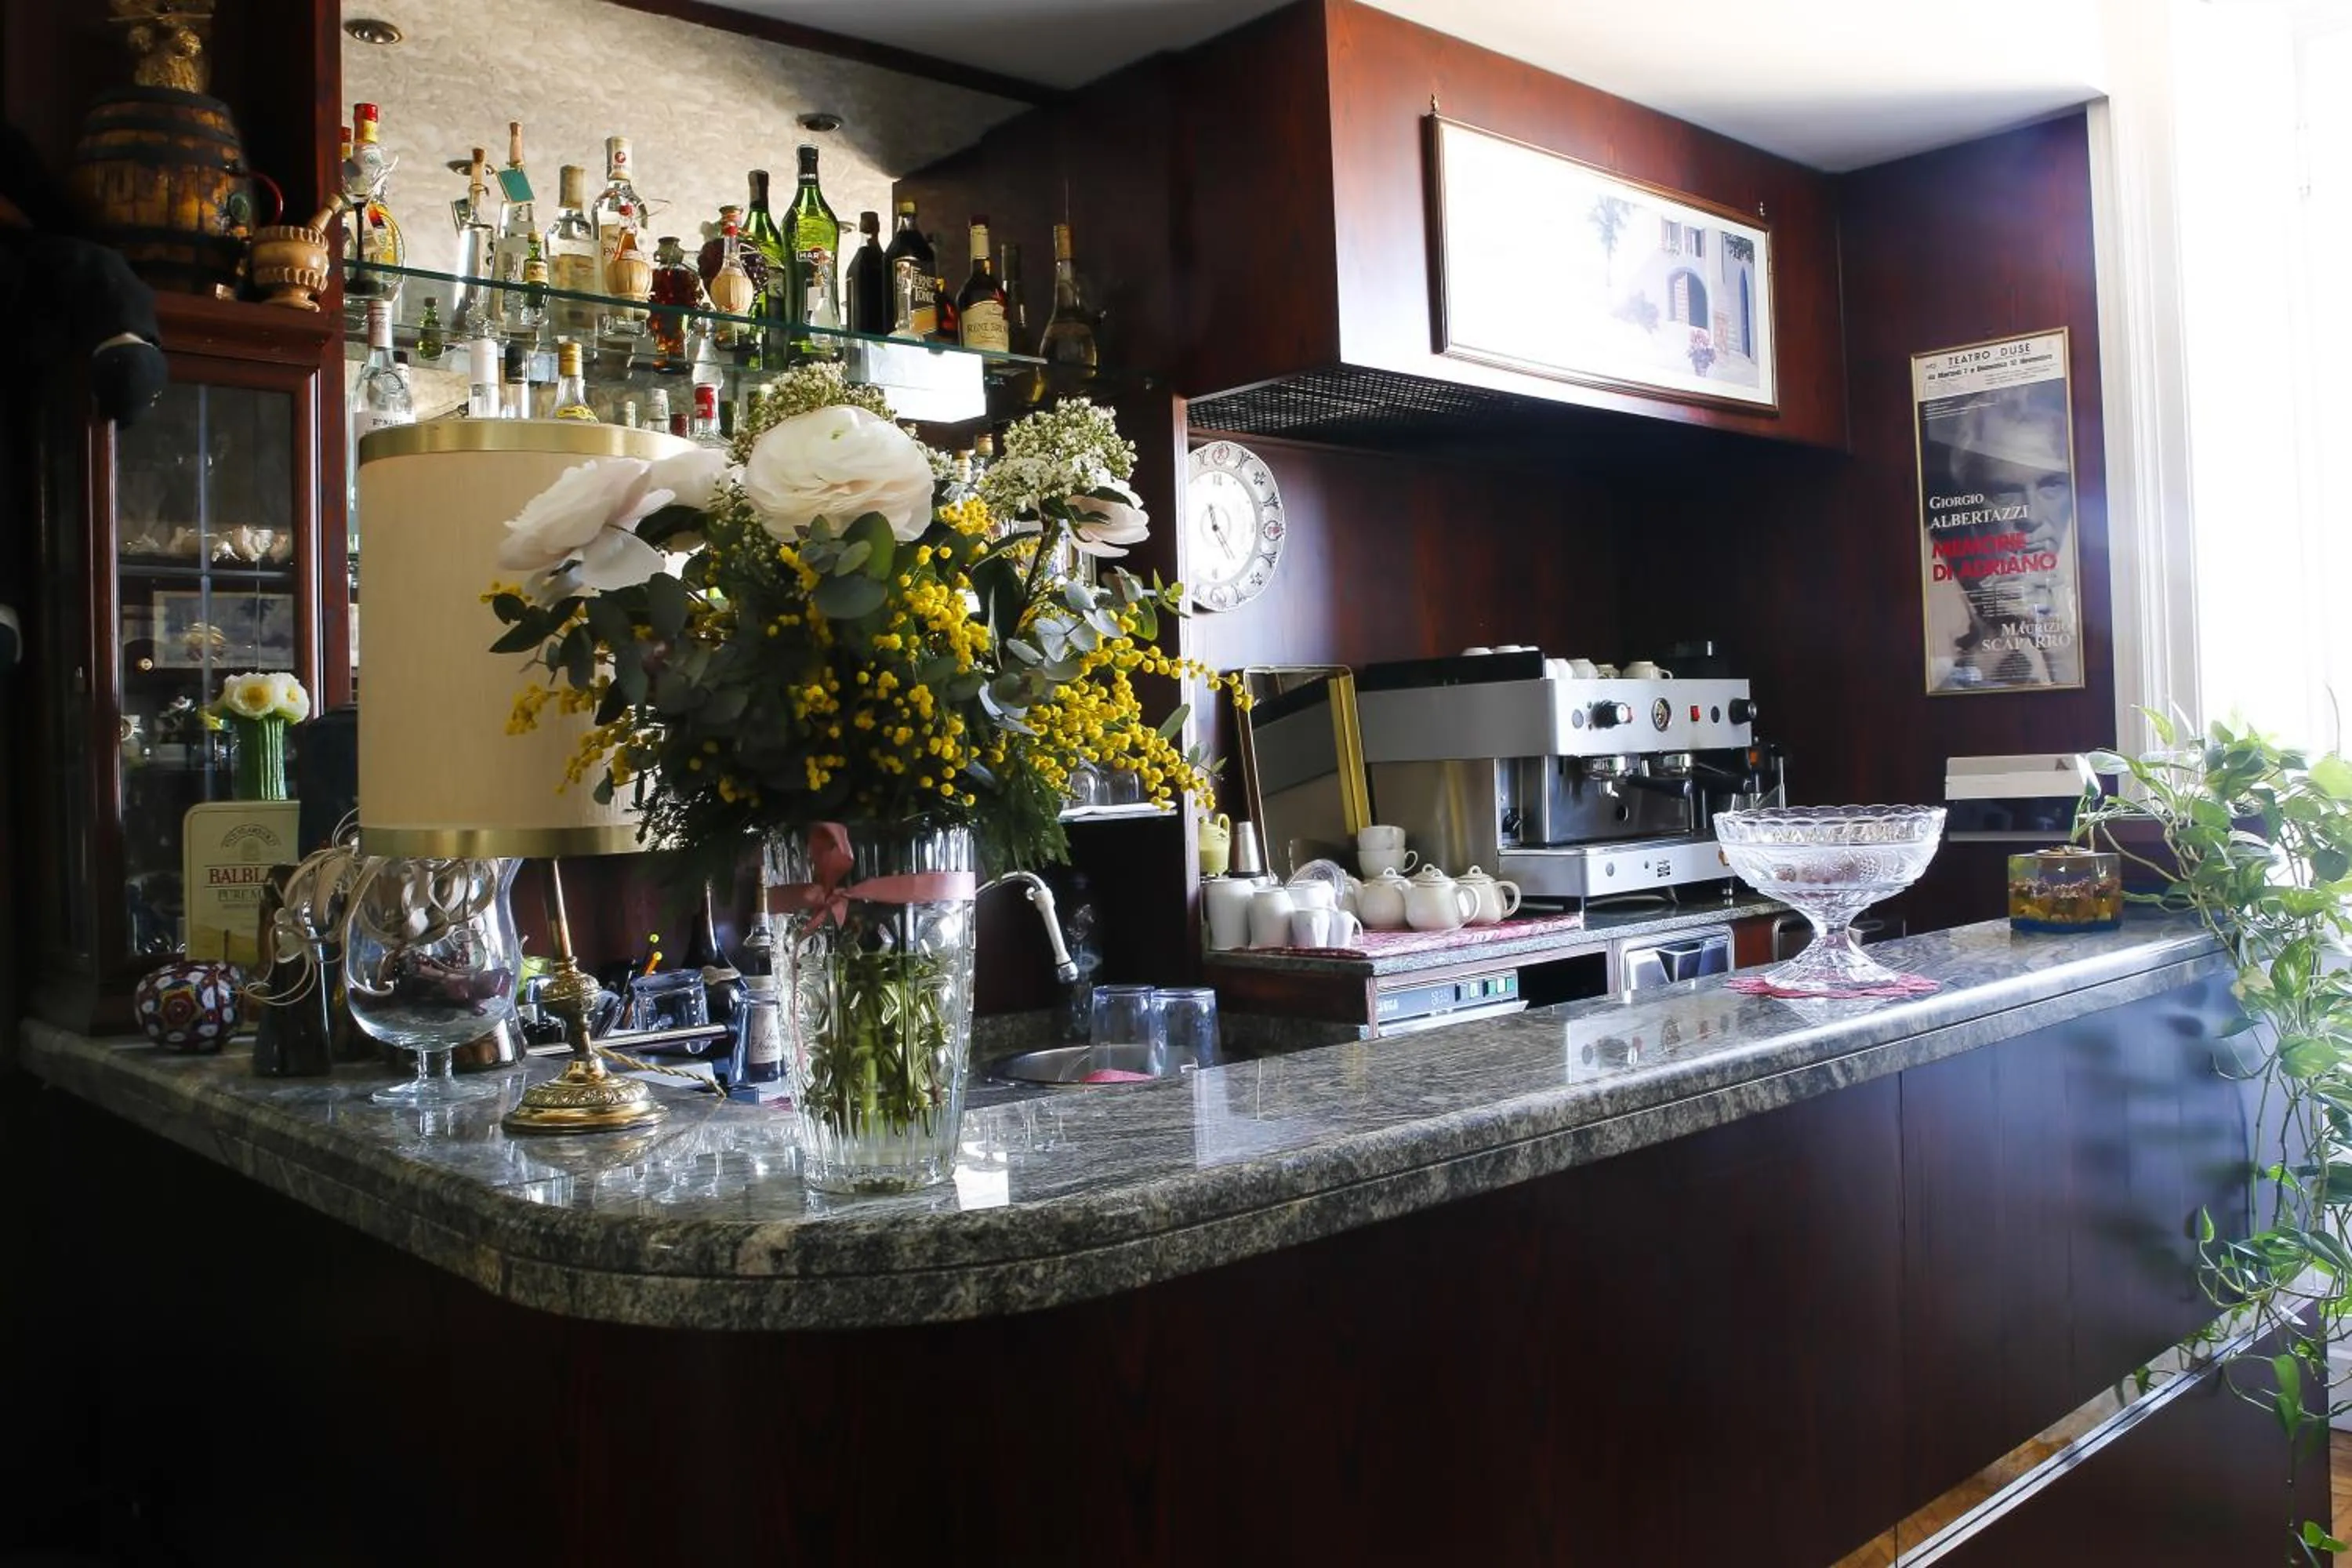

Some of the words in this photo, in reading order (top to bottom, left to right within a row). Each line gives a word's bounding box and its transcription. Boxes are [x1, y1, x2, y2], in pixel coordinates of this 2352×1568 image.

[910, 266, 936, 290] FERNE
[1948, 350, 1991, 365] TEATRO
[2000, 343, 2031, 357] DUSE
[1929, 493, 1984, 510] GIORGIO
[1929, 504, 2030, 530] ALBERTAZZI
[1931, 530, 2027, 559] MEMORIE
[1932, 562, 1954, 583] DI
[1957, 552, 2058, 579] ADRIANO
[2001, 620, 2069, 637] MAURIZI
[1981, 633, 2072, 652] SCAPARRO
